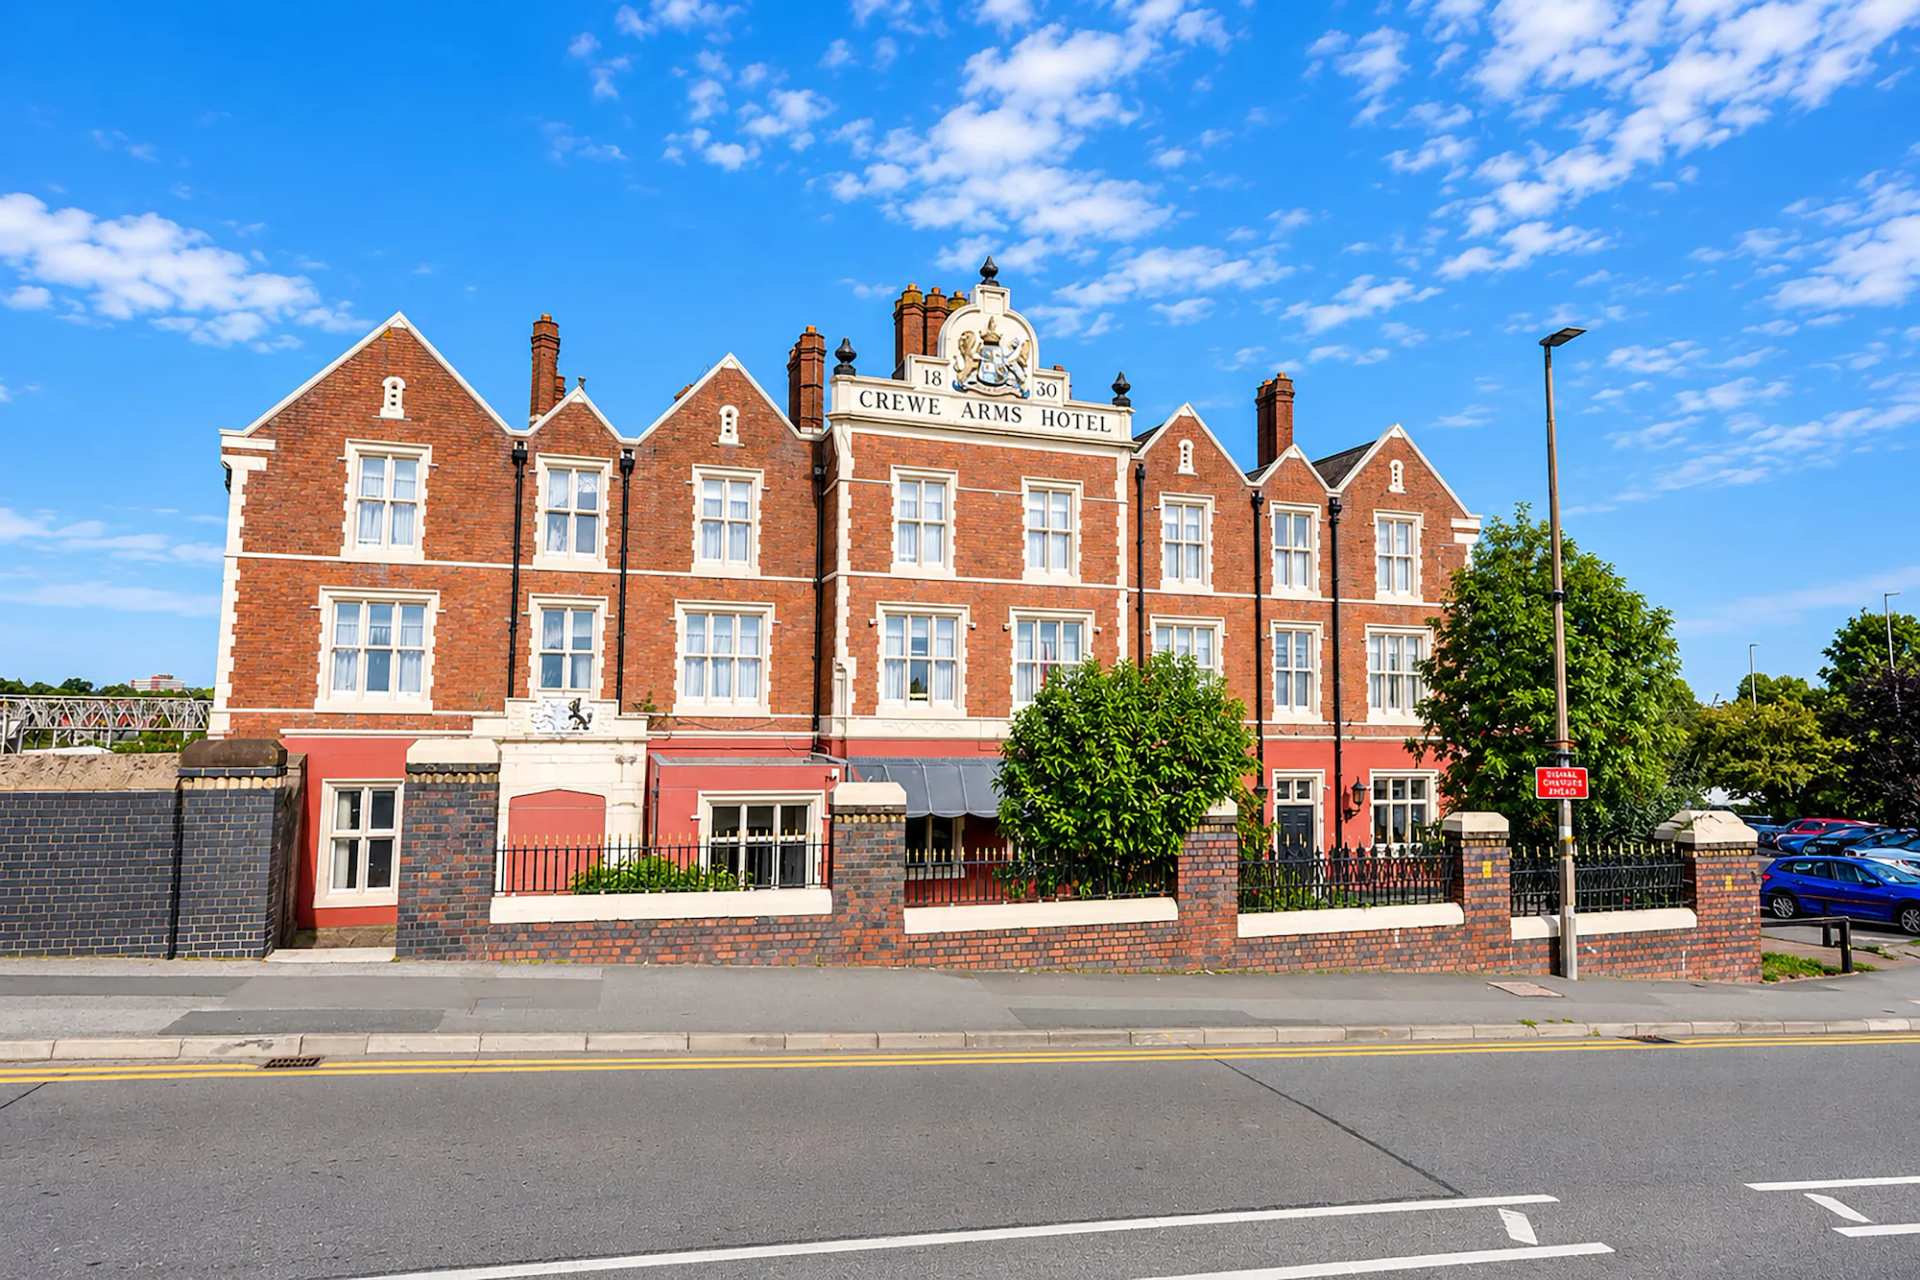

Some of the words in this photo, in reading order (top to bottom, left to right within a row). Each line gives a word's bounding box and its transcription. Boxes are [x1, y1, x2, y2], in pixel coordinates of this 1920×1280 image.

[924, 369, 942, 387] 18
[1036, 381, 1057, 398] 30
[859, 390, 942, 416] CREWE
[961, 402, 1022, 424] ARMS
[1042, 410, 1112, 433] HOTEL
[1548, 787, 1576, 795] AHEAD
